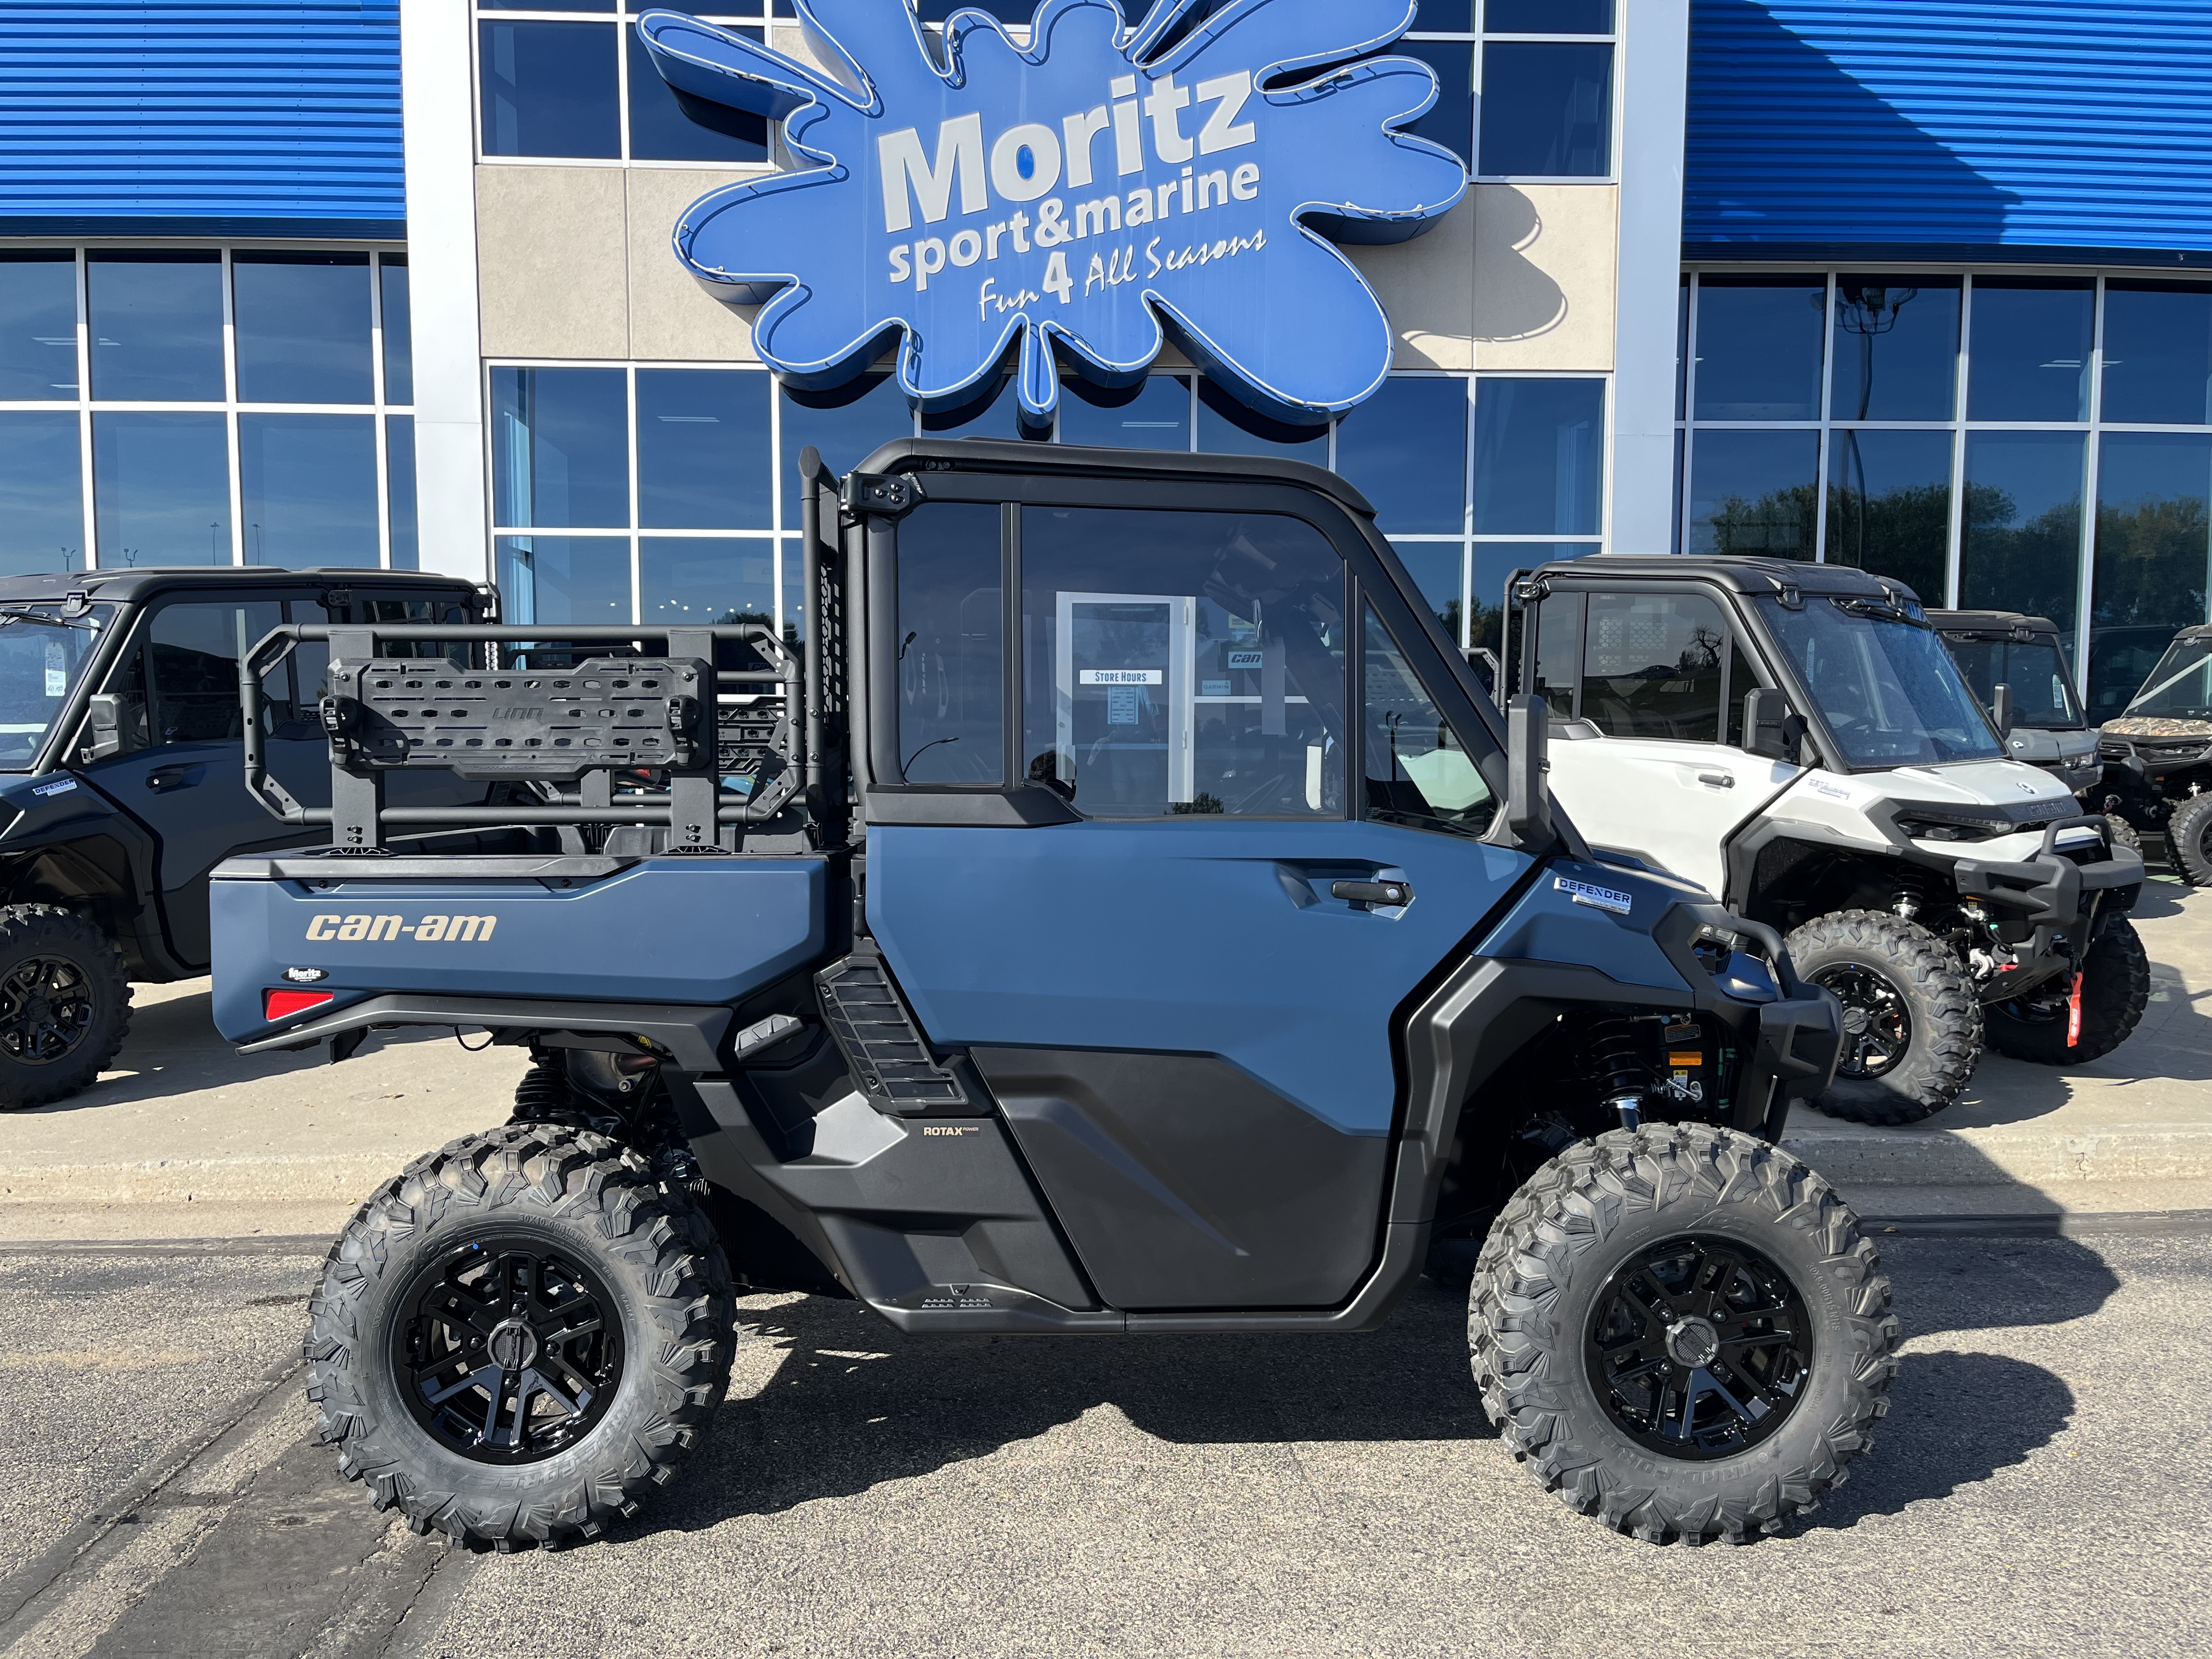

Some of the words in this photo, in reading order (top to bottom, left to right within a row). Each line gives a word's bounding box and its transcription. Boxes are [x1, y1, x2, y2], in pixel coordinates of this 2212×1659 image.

[877, 68, 1257, 234] Moritz
[888, 161, 1262, 292] sport&marine
[978, 276, 1041, 322] Fun
[1041, 250, 1074, 304] 4
[1084, 244, 1139, 298] All
[1144, 228, 1267, 280] Seasons
[35, 779, 75, 794] DEFENDER
[1560, 879, 1630, 904] DEFENDER
[306, 915, 497, 941] can-am
[288, 967, 321, 978] Moritz
[923, 1127, 963, 1136] ROTAX
